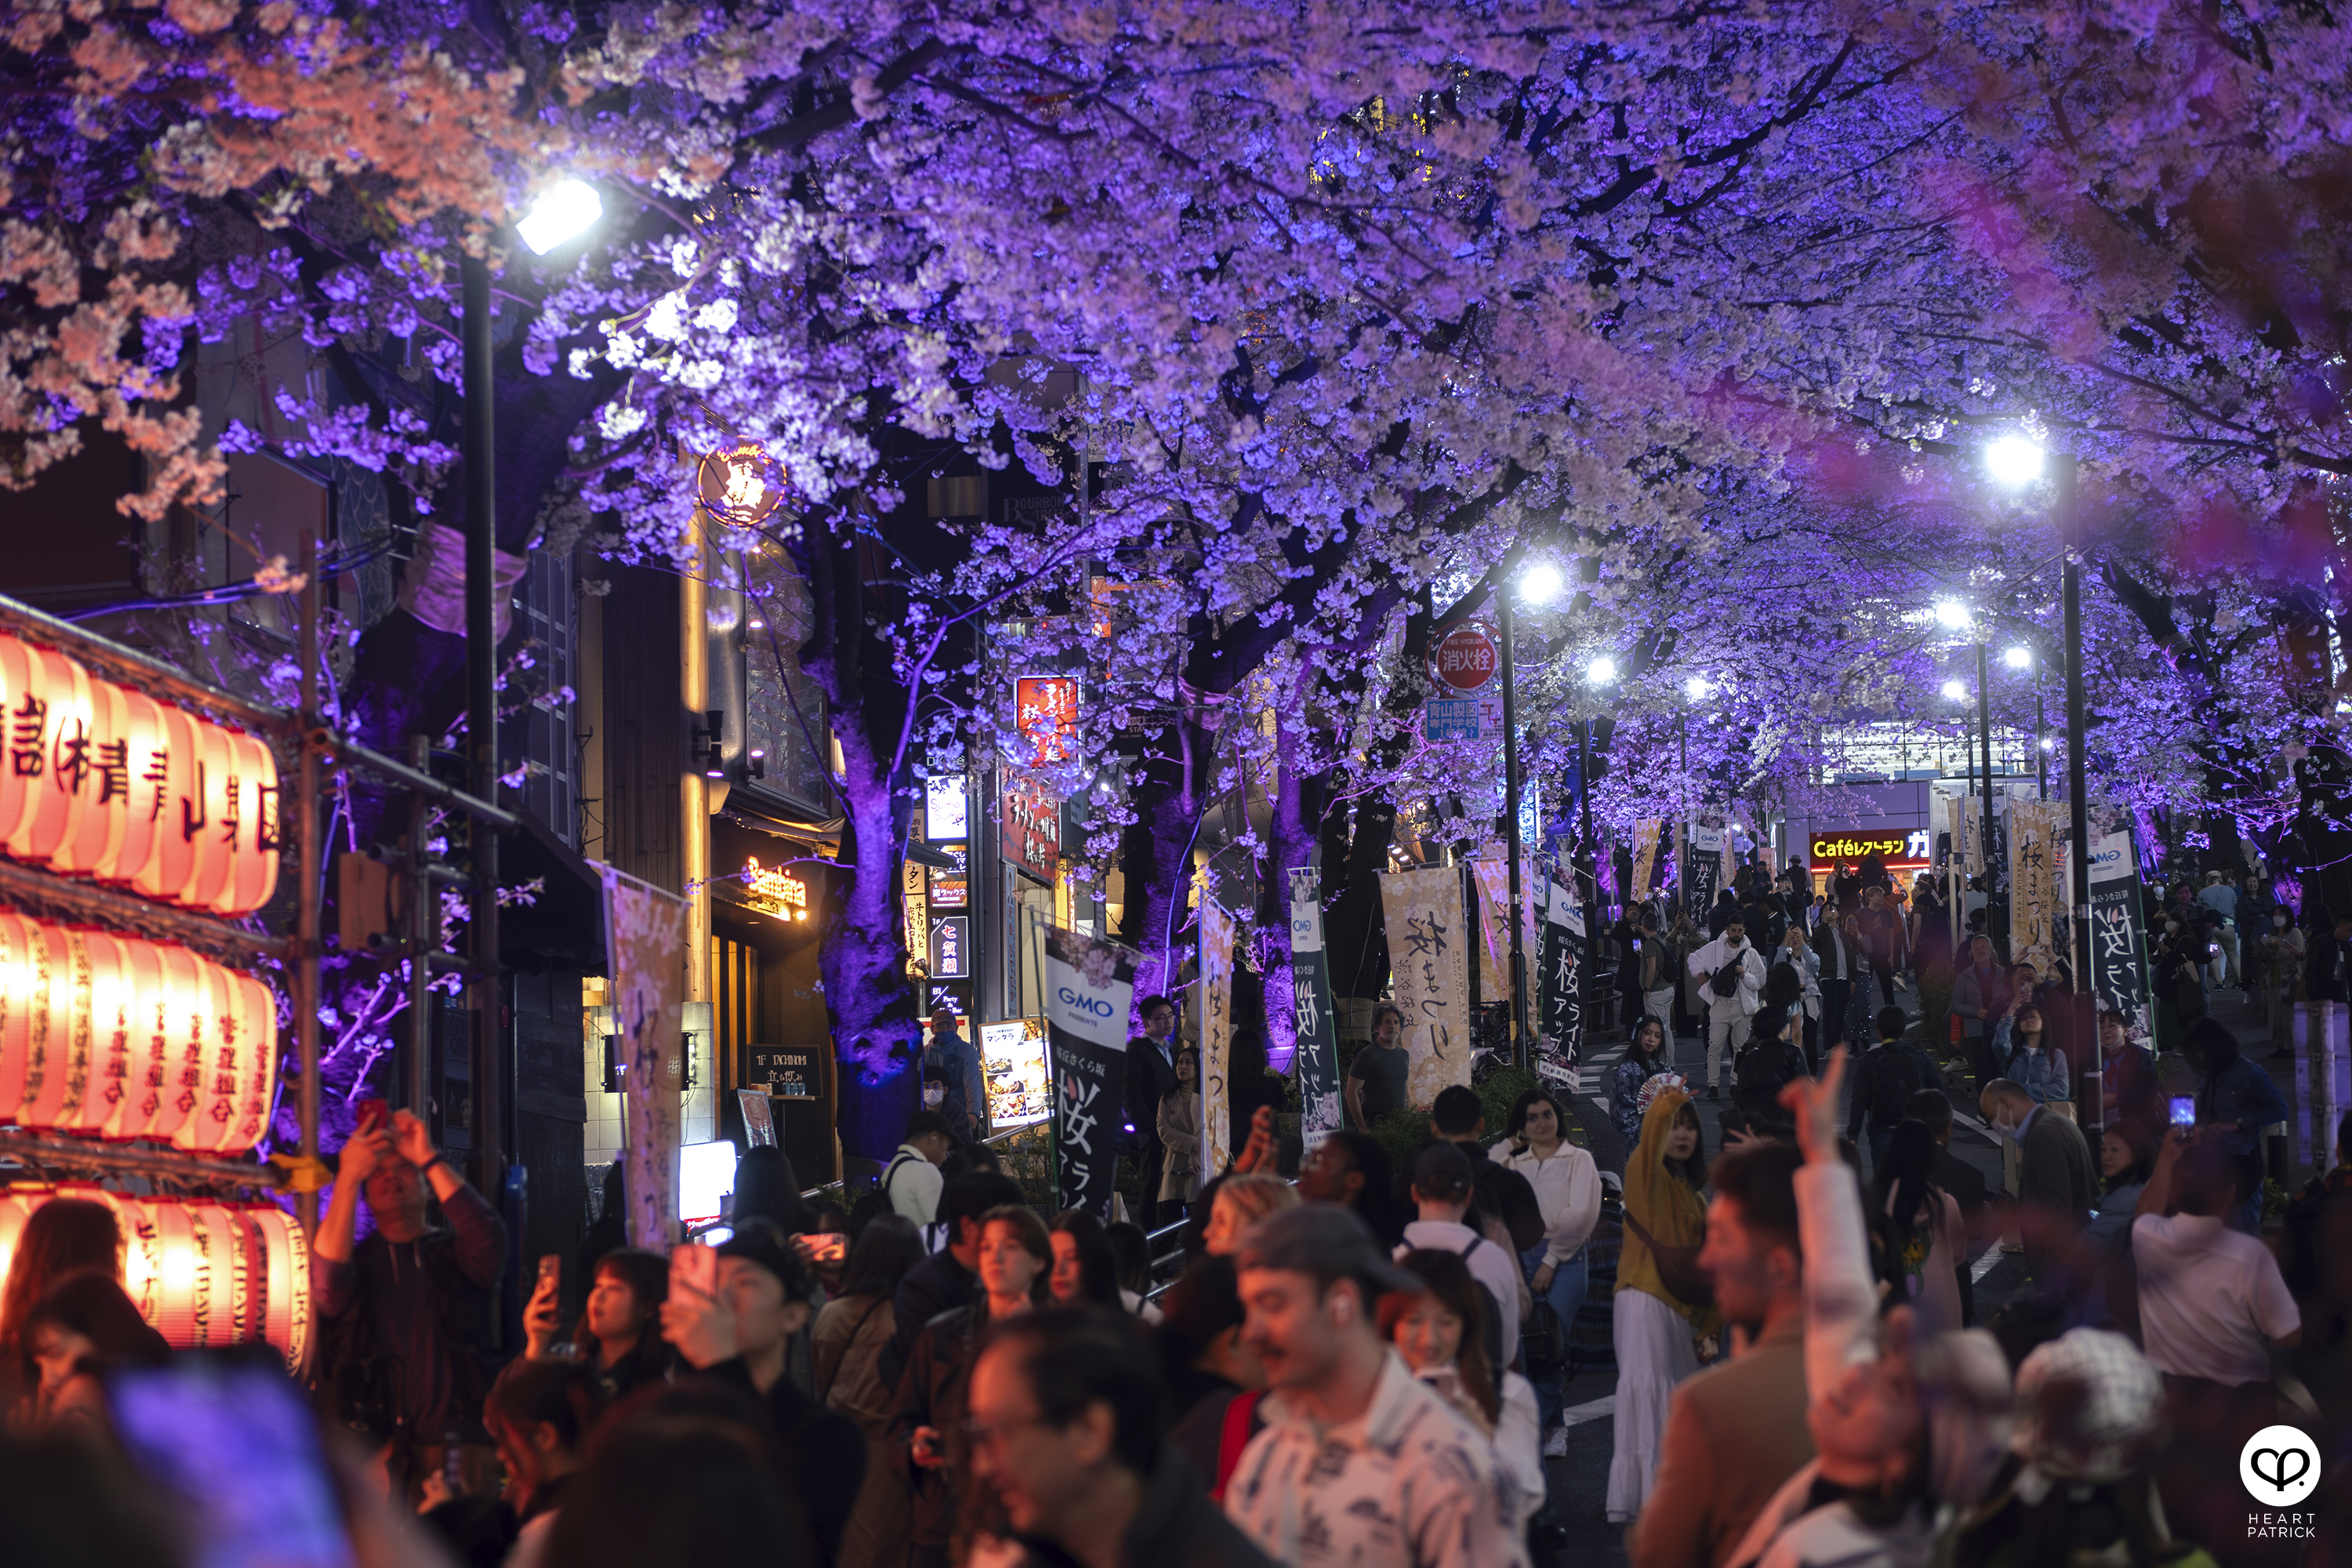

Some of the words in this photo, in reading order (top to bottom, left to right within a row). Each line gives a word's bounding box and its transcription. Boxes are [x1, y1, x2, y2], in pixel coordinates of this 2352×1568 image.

[1002, 497, 1065, 522] BOURBON
[1443, 648, 1491, 672] 消火栓
[1428, 702, 1478, 719] 青山製図
[1428, 718, 1478, 729] 専門学校
[1694, 863, 1714, 889] 桜
[2020, 834, 2044, 946] 桜まつり
[1561, 901, 1584, 921] GMO
[2041, 872, 2050, 924] 渋谷桜丘
[916, 902, 924, 949] 牛トリッパと
[1555, 947, 1581, 999] 桜
[1058, 986, 1114, 1018] GMO
[1549, 996, 1566, 1054] アップ
[1564, 1002, 1580, 1062] ライト
[756, 1054, 767, 1065] 1F
[767, 1069, 804, 1083] 立ち飲み
[1057, 1068, 1101, 1155] 桜
